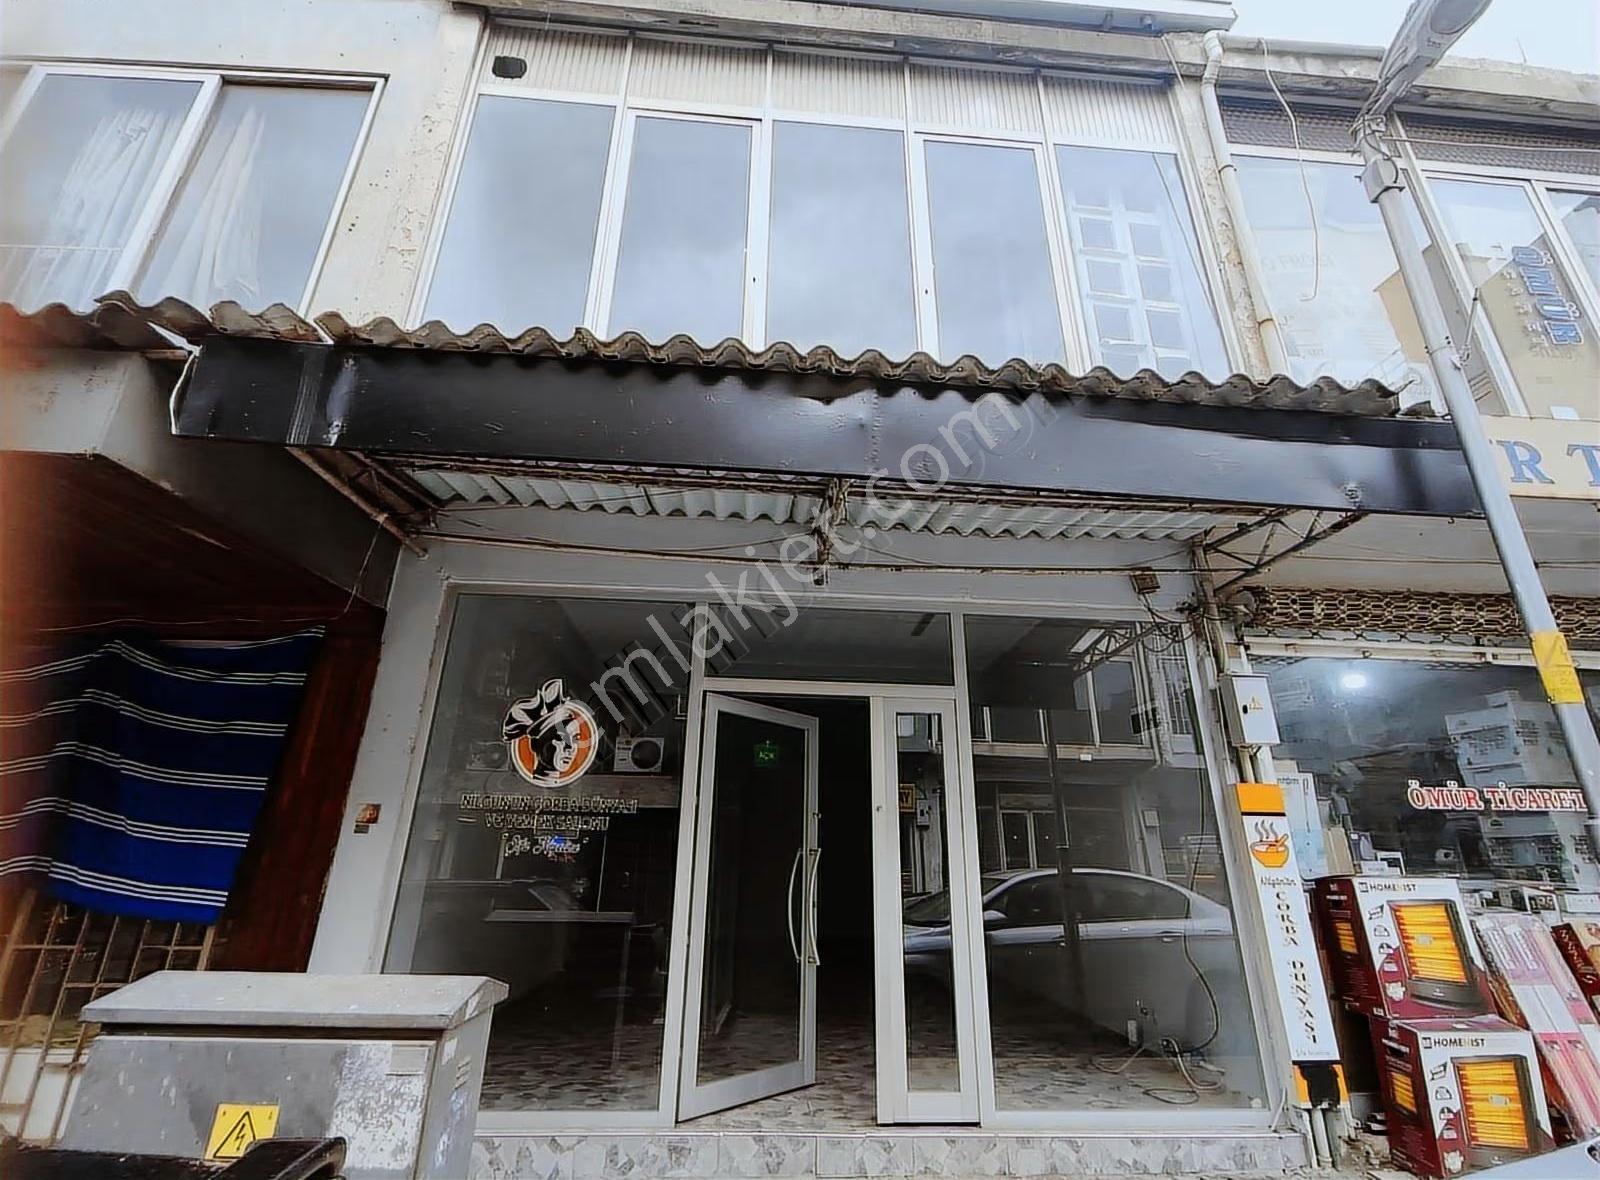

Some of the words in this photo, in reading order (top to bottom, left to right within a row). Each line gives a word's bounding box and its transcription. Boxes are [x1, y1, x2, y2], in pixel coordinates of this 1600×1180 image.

[1489, 438, 1556, 484] R
[1408, 780, 1484, 810] ÖMÜR
[1483, 781, 1588, 812] TİCARET
